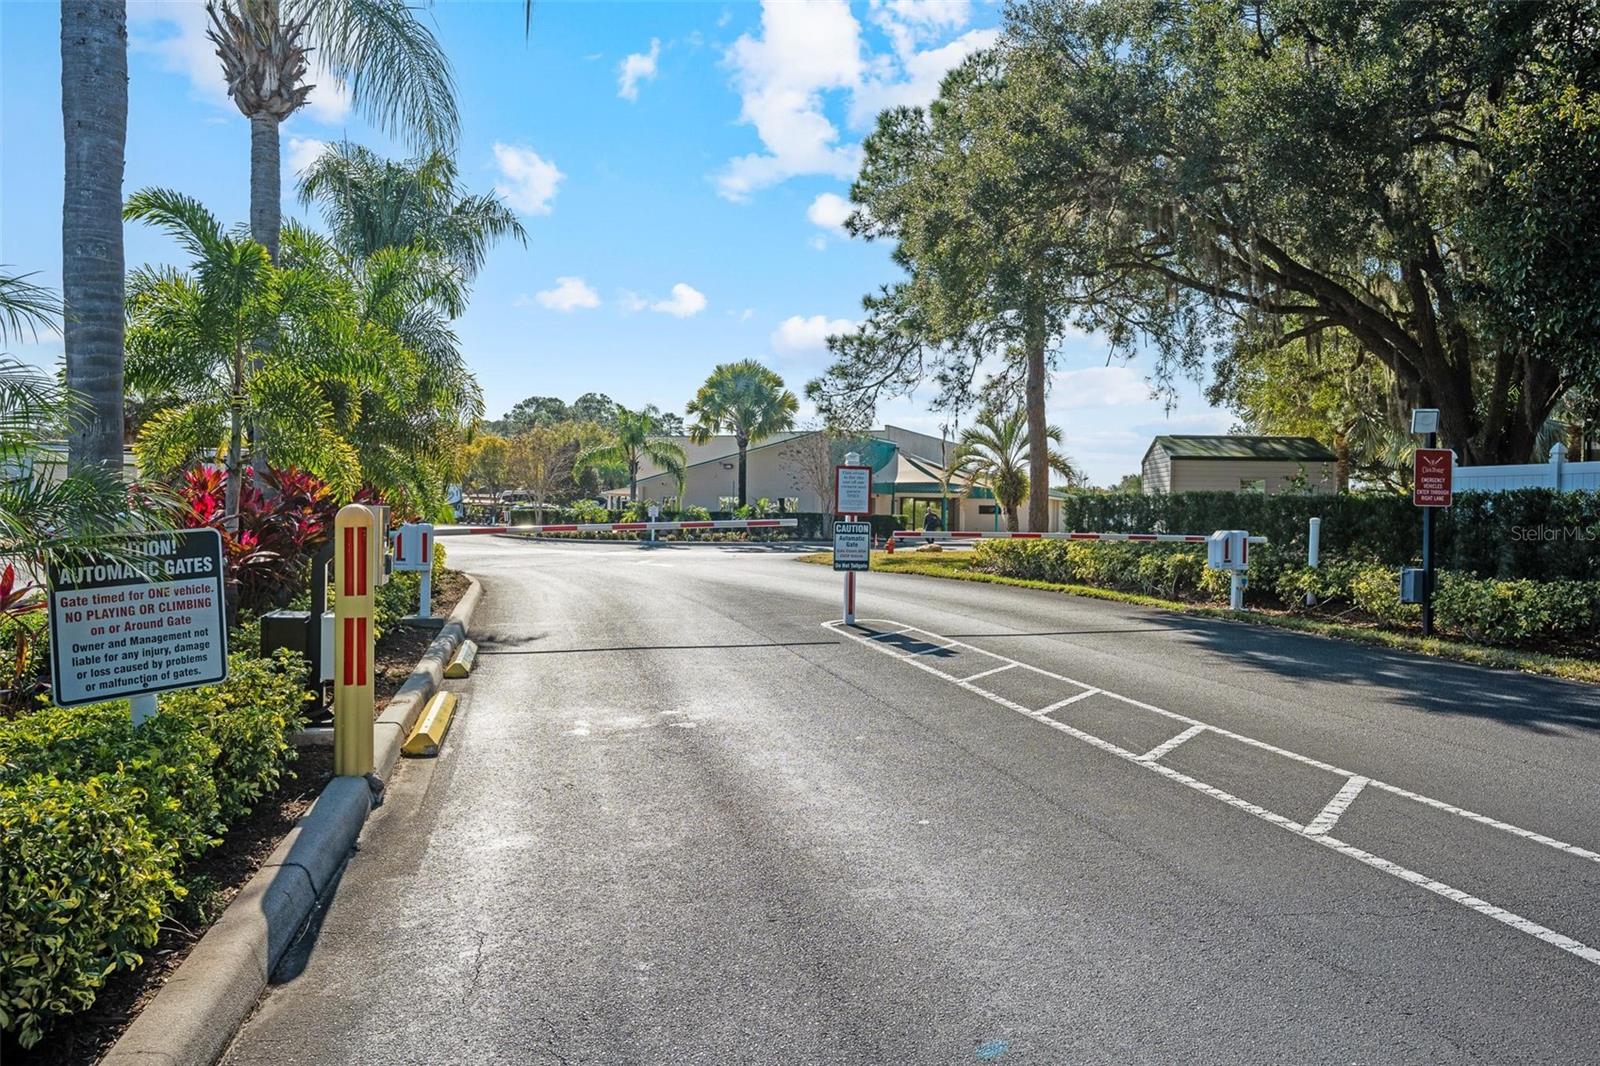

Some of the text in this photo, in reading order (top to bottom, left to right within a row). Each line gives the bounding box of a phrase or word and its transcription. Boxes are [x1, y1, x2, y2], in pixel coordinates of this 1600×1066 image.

[836, 524, 869, 533] CAUTION
[164, 557, 213, 575] GATES
[60, 584, 214, 608] Gate timed for ONE vehicle.
[65, 598, 212, 623] NO PLAYING OR CLIMBING
[91, 615, 191, 636] on or Around Gate
[72, 628, 208, 653] Owner and Management not
[72, 641, 210, 667] liable for any injury, damage
[77, 653, 207, 679] or loss caused by problems
[85, 667, 202, 692] or malfunction of gates.
